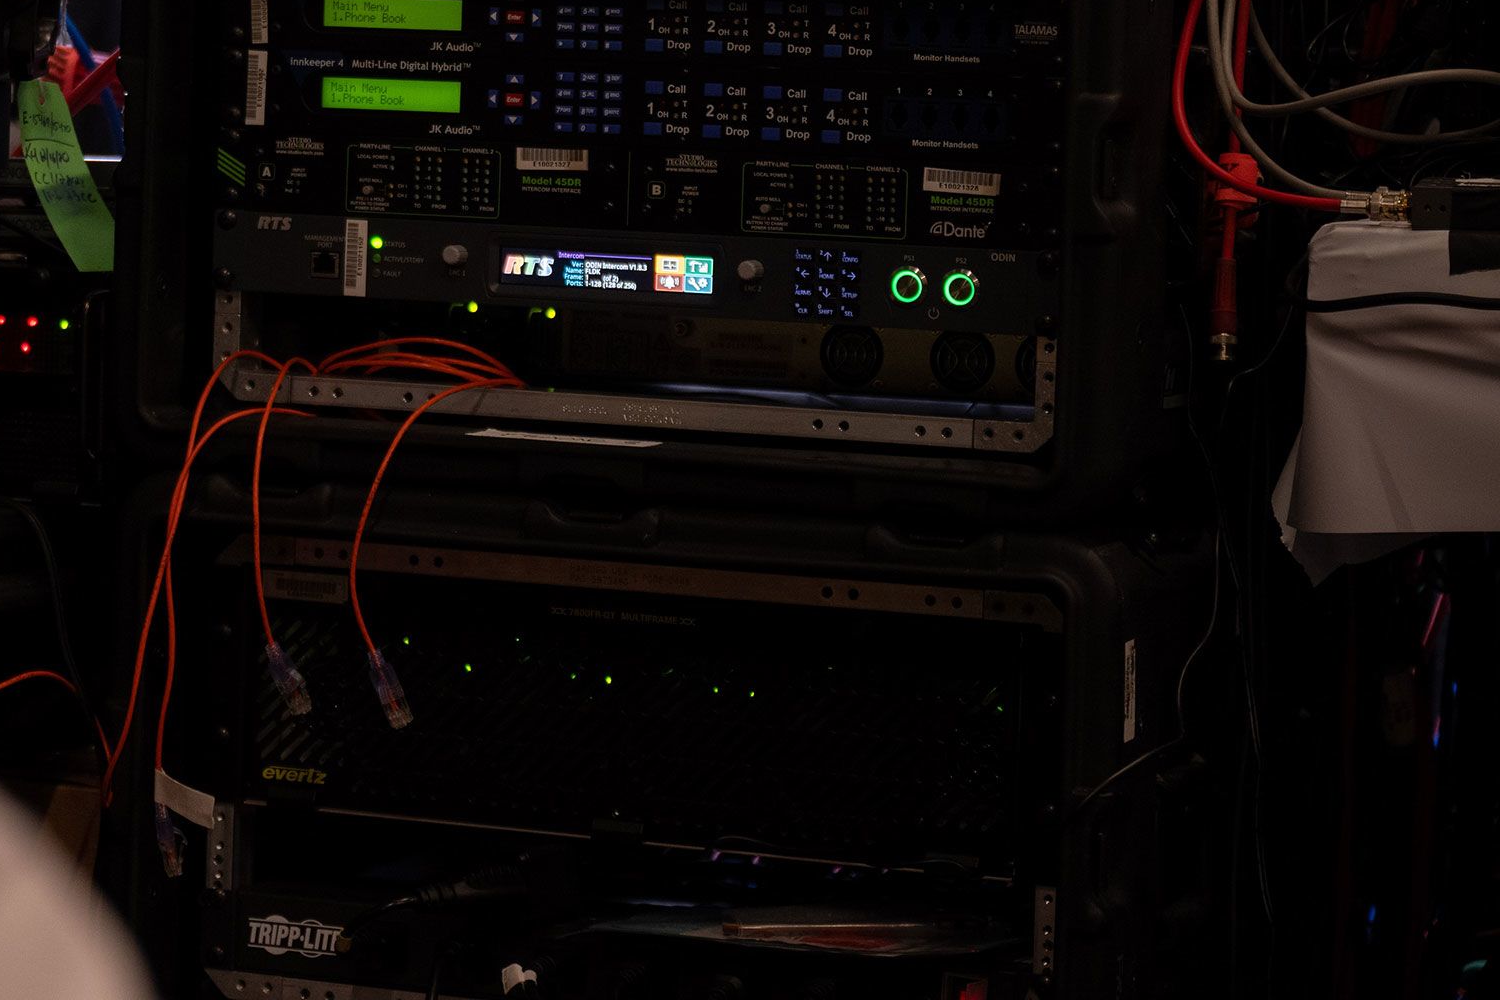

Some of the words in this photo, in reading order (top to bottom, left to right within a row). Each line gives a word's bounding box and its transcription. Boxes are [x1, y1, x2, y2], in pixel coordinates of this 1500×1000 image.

[332, 0, 358, 11] Main
[363, 1, 390, 13] Menu
[668, 0, 688, 10] Call
[728, 2, 748, 12] Call
[788, 4, 808, 14] Call
[849, 6, 869, 16] Call
[332, 12, 376, 23] 1.Phone
[381, 13, 407, 24] Book
[648, 18, 655, 31] 1
[707, 20, 716, 32] 2
[767, 22, 776, 35] 3
[1014, 24, 1058, 36] TALAMAS
[828, 24, 837, 37] 4
[429, 42, 443, 52] JK
[667, 40, 691, 51] Drop
[726, 42, 751, 53] Drop
[787, 44, 811, 55] Drop
[848, 46, 873, 57] Drop
[913, 53, 943, 62] Monitor
[945, 55, 981, 63] Handsets
[290, 56, 336, 70] Innkeeper
[351, 59, 398, 70] Multi-Line
[400, 60, 430, 72] Digital
[330, 82, 357, 93] Main
[361, 83, 388, 95] Menu
[667, 84, 687, 94] Call
[727, 86, 746, 96] Call
[787, 89, 807, 99] Call
[331, 94, 374, 105] 1.Phone
[380, 95, 405, 106] Book
[848, 92, 868, 101] Call
[647, 102, 654, 115] 1
[706, 104, 715, 117] 2
[766, 106, 775, 119] 3
[826, 109, 835, 122] 4
[428, 124, 442, 134] JK
[666, 124, 690, 135] Drop
[725, 127, 750, 137] Drop
[786, 129, 810, 140] Drop
[846, 131, 871, 142] Drop
[912, 139, 941, 148] Monitor
[943, 140, 979, 149] Handsets
[866, 165, 893, 173] CHANNEL
[522, 176, 552, 186] Model
[554, 177, 582, 187] 45DR
[930, 195, 963, 205] Model
[965, 197, 994, 207] 45DR
[257, 215, 292, 231] RTS
[943, 222, 986, 238] Dante
[558, 251, 585, 260] Intercom
[990, 252, 1016, 263] ODIN
[503, 254, 555, 277] RTS
[565, 267, 584, 275] Name:
[602, 262, 629, 270] Intercom
[566, 279, 584, 287] Ports:
[261, 767, 327, 785] evertz
